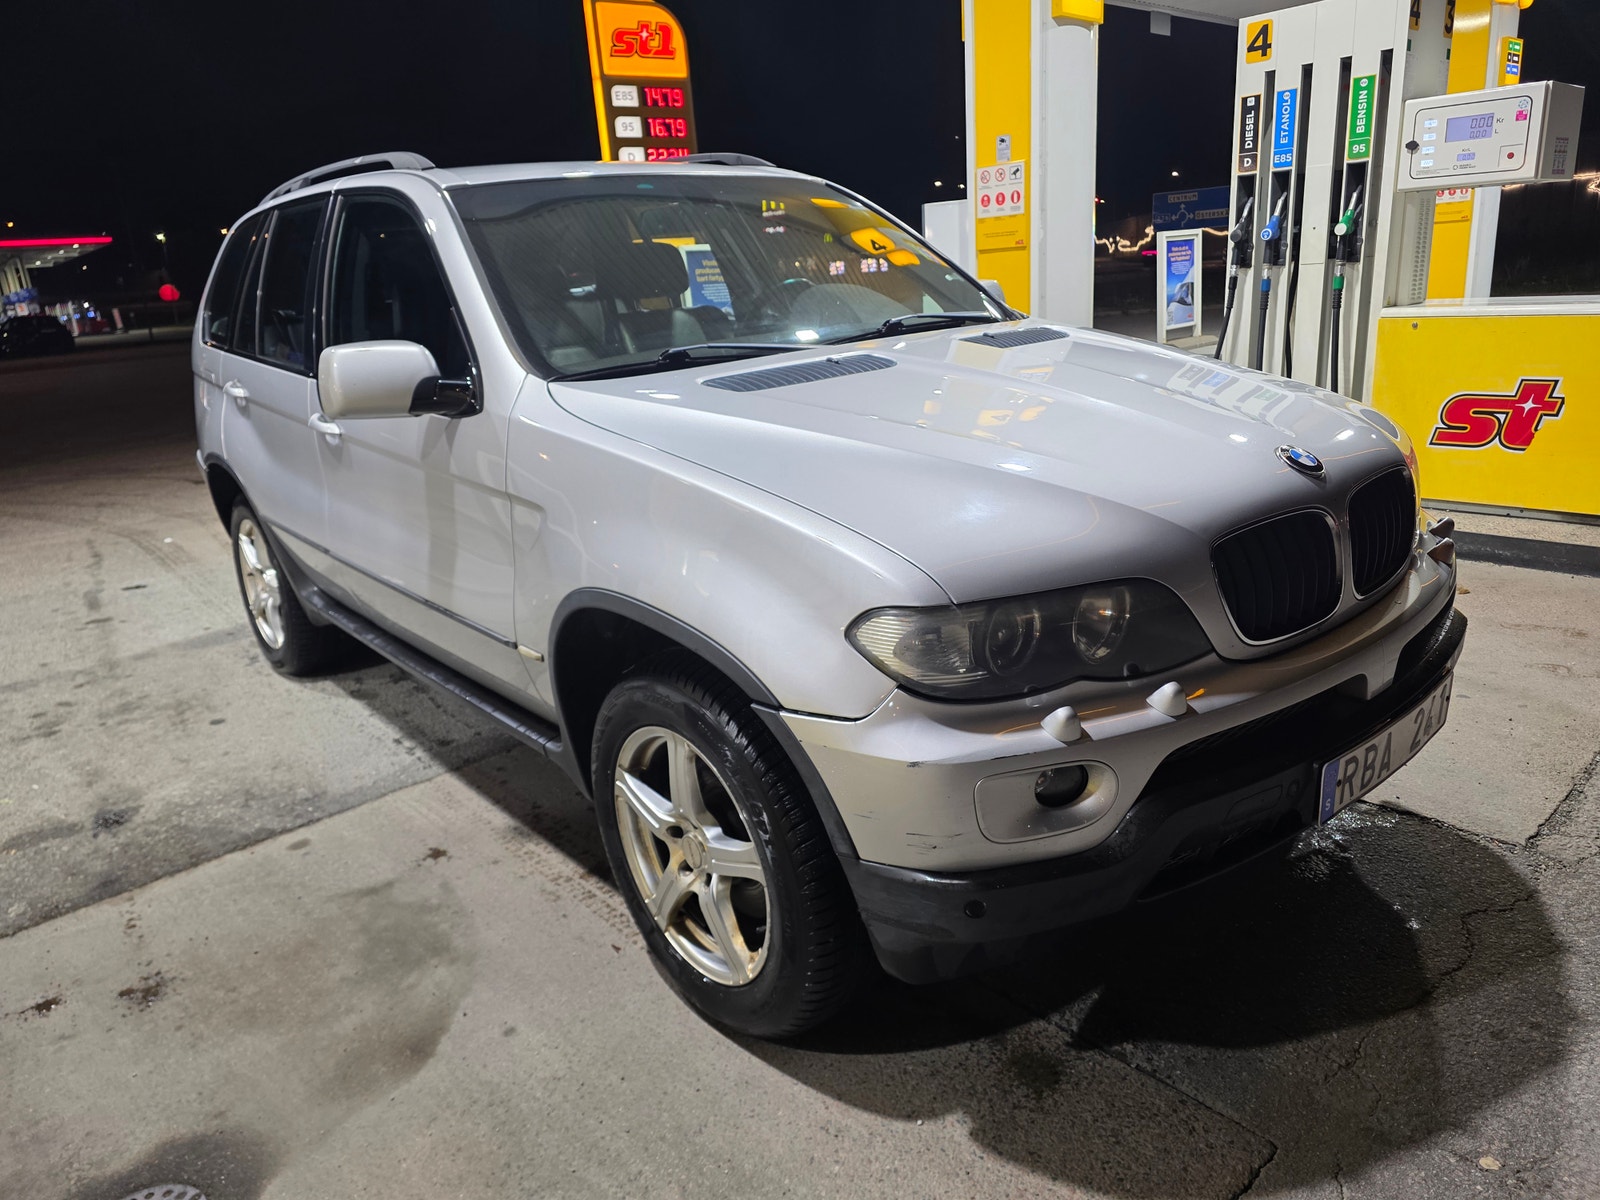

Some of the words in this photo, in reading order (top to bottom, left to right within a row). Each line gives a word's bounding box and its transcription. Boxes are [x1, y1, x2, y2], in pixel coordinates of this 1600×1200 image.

[1247, 24, 1272, 57] 4
[615, 91, 634, 101] E85
[1356, 90, 1368, 133] BENSIN
[1280, 98, 1291, 144] ETANOL
[621, 122, 635, 132] 95
[647, 118, 687, 138] 16.79
[1245, 110, 1254, 149] DIESEL
[1352, 143, 1366, 154] 95
[627, 152, 636, 161] D
[1244, 157, 1252, 167] D
[1274, 153, 1292, 163] E85
[1168, 193, 1197, 202] CENTRUM
[1340, 732, 1393, 804] RBA
[1325, 798, 1331, 811] S
